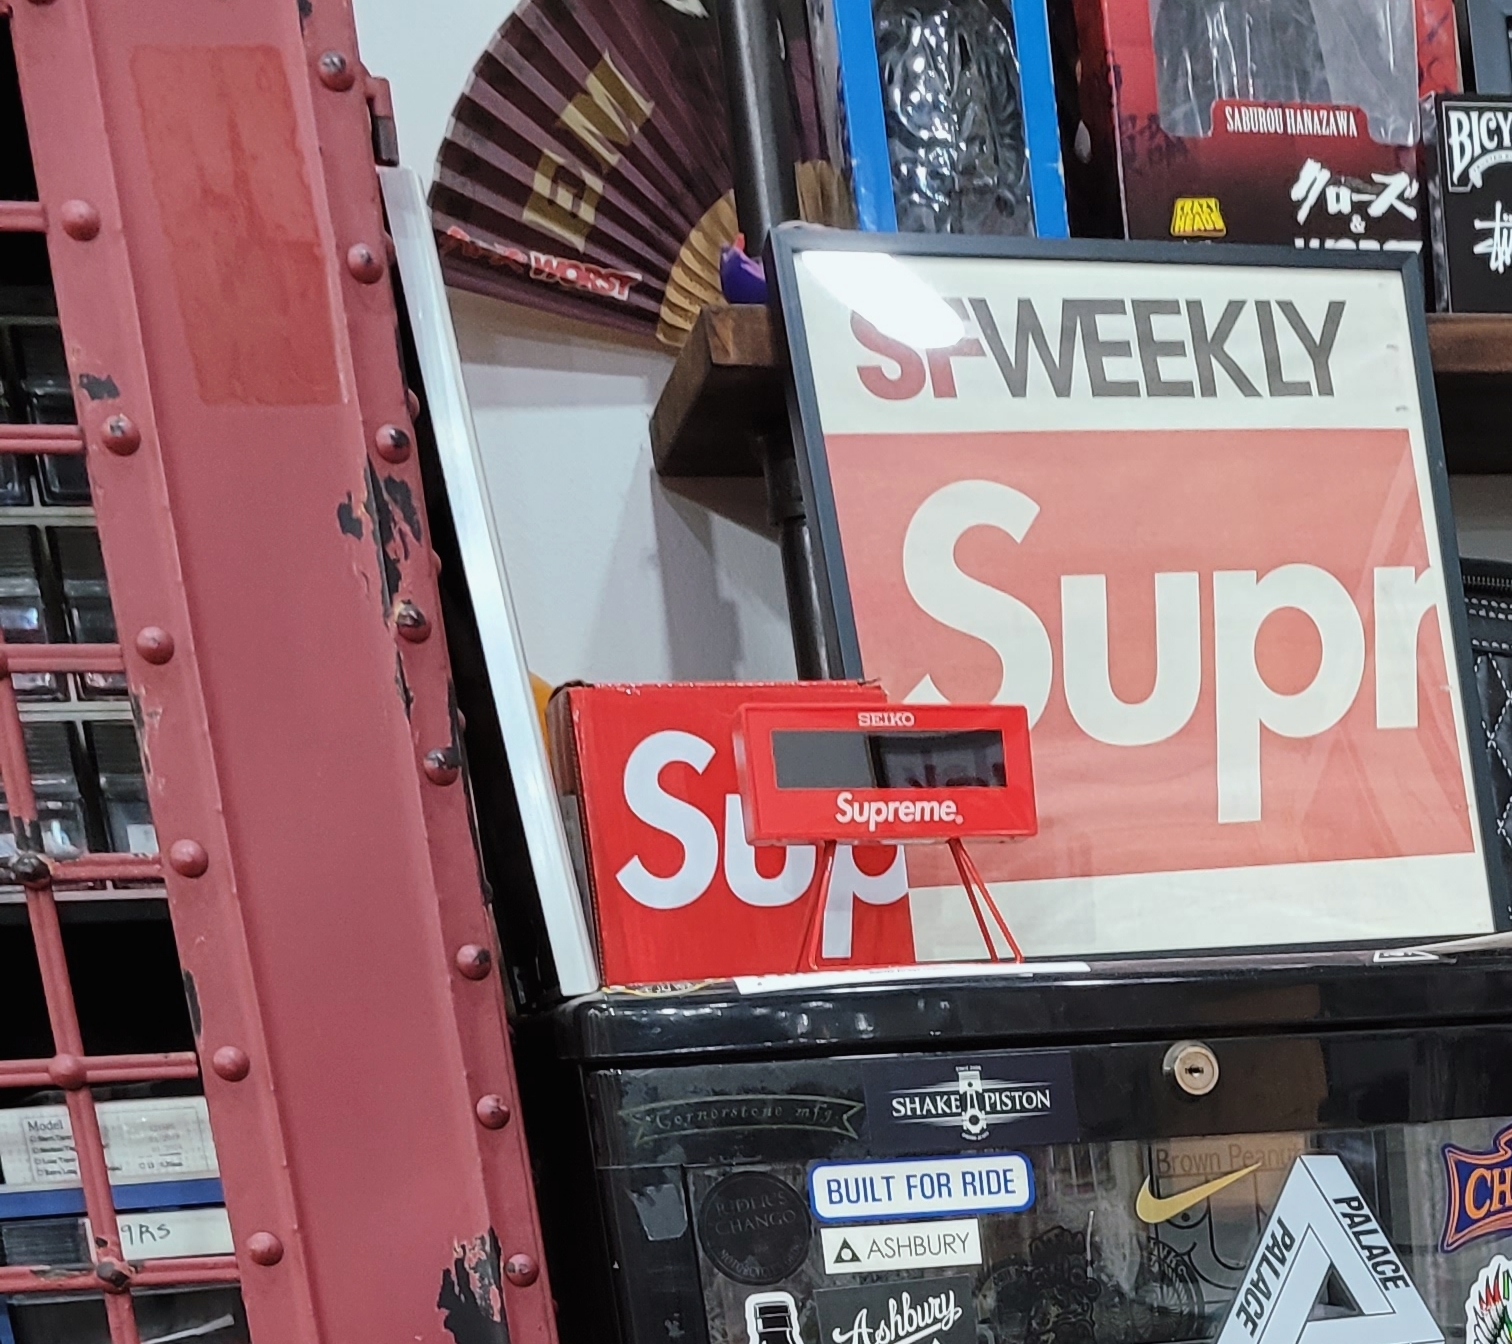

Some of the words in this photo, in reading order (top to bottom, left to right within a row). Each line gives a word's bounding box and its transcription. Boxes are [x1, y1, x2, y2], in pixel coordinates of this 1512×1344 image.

[1225, 105, 1284, 134] SABUROU
[1286, 106, 1358, 138] HANAZAWA
[1290, 157, 1420, 226] クローズ
[858, 711, 915, 727] SEIKO
[891, 1094, 962, 1117] SHAKE
[983, 1089, 1051, 1112] PISTON
[27, 1119, 65, 1132] Model
[1155, 1148, 1222, 1175] Brown
[826, 1174, 896, 1206] BUILT
[906, 1171, 952, 1201] FOR
[961, 1167, 1017, 1197] RIDE
[715, 1209, 797, 1235] CHANGO
[866, 1231, 971, 1260] ASHBURY
[1332, 1194, 1410, 1293] PALACE
[1235, 1217, 1297, 1338] PALACE
